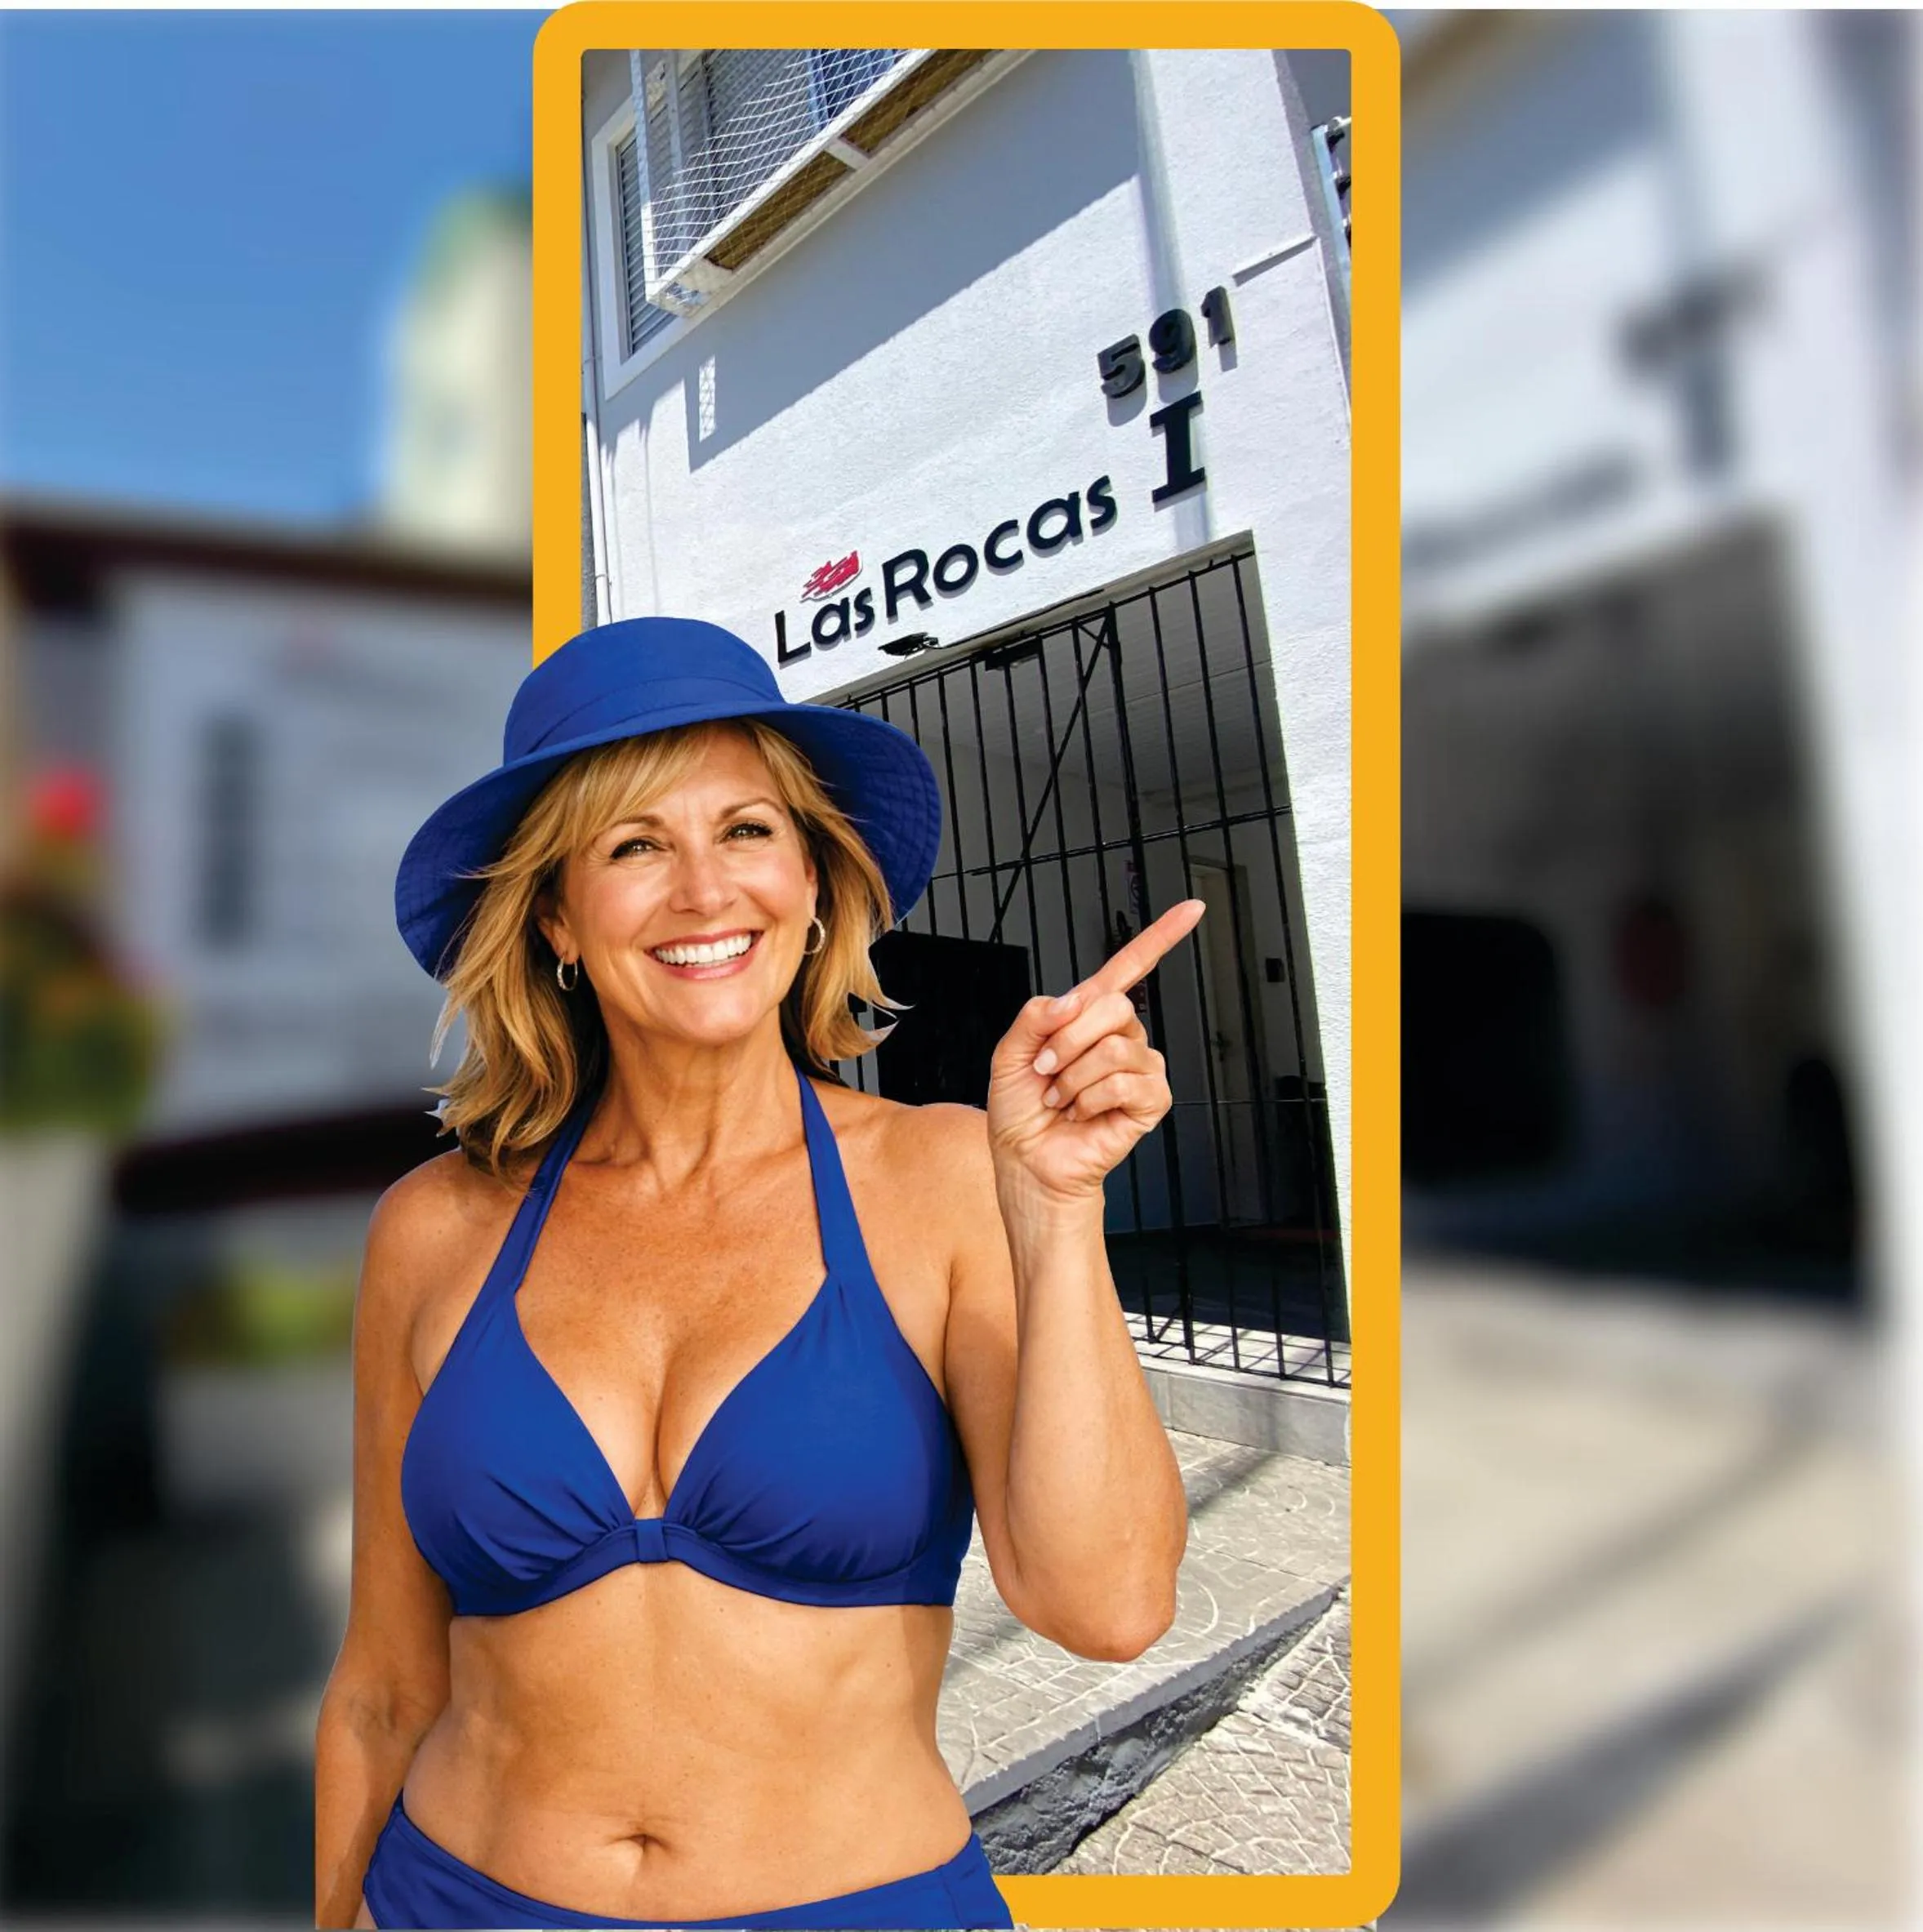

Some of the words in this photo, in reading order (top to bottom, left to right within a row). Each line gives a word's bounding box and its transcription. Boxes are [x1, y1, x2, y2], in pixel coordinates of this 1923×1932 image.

[1097, 285, 1235, 399] 591
[775, 586, 875, 664] Las
[882, 474, 1117, 618] Rocas
[1150, 390, 1206, 504] I
